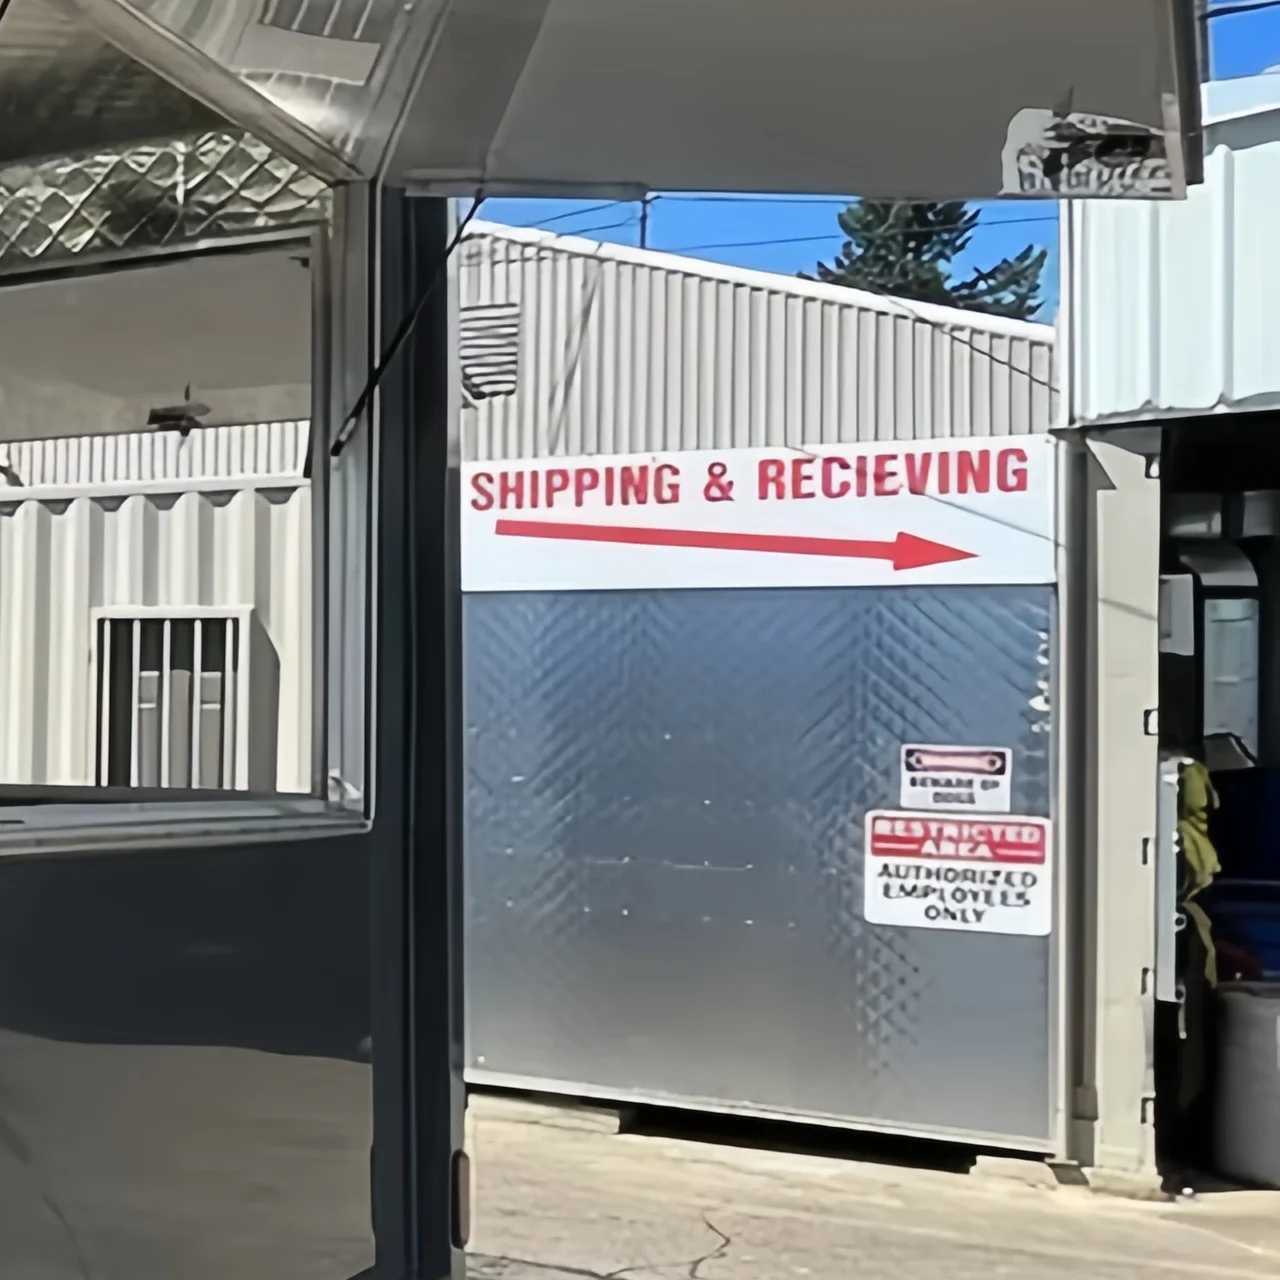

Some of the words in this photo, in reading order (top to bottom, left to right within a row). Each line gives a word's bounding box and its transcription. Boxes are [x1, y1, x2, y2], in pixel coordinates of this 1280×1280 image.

[470, 463, 681, 512] SHIPPING
[703, 461, 736, 503] &
[757, 447, 1029, 501] RECIEVING
[873, 818, 1041, 844] RESTRICTED
[920, 839, 994, 858] AREA
[877, 863, 1038, 888] AUTHORIZED
[924, 904, 987, 923] ONLY
